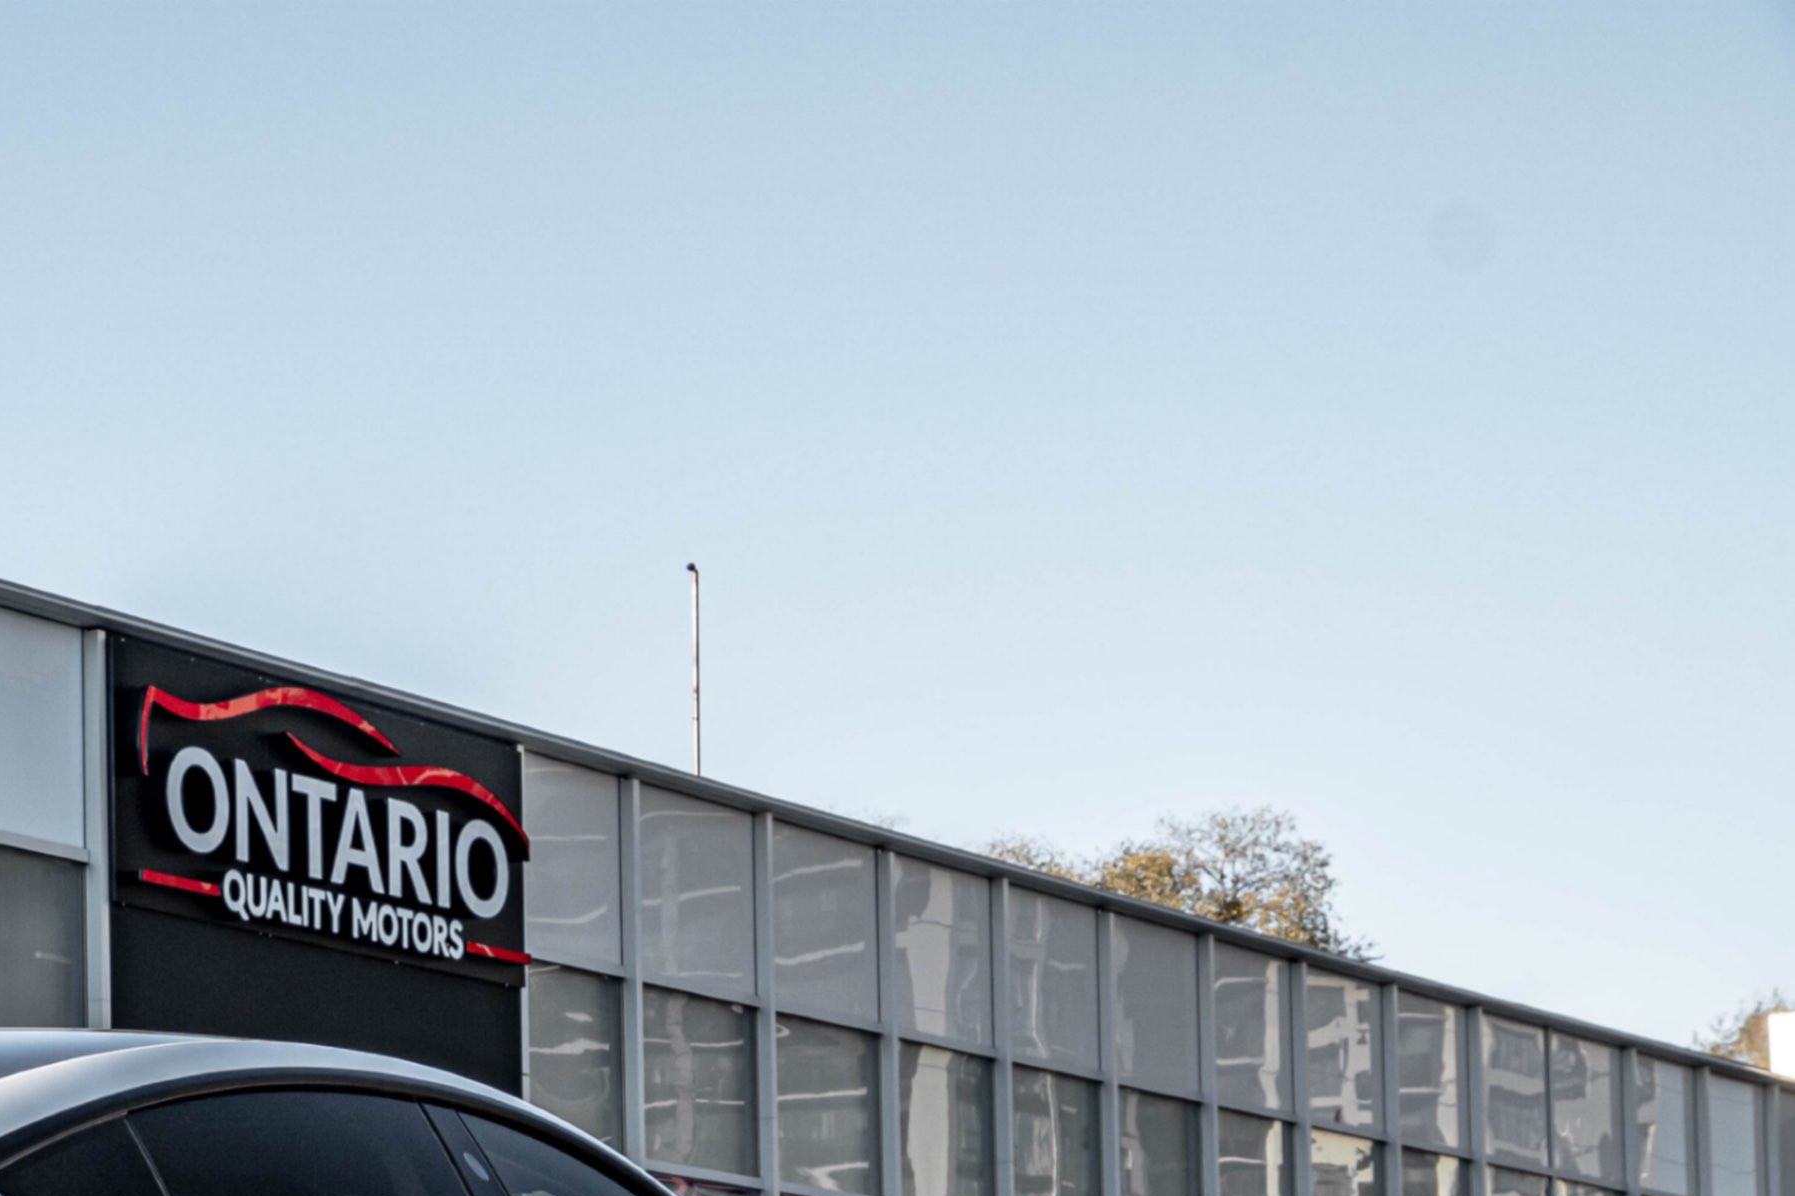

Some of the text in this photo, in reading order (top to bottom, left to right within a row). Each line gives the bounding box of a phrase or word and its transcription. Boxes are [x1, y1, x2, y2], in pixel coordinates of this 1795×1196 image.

[166, 746, 509, 919] ONTARIO
[222, 869, 465, 960] QUALITY MOTORS
